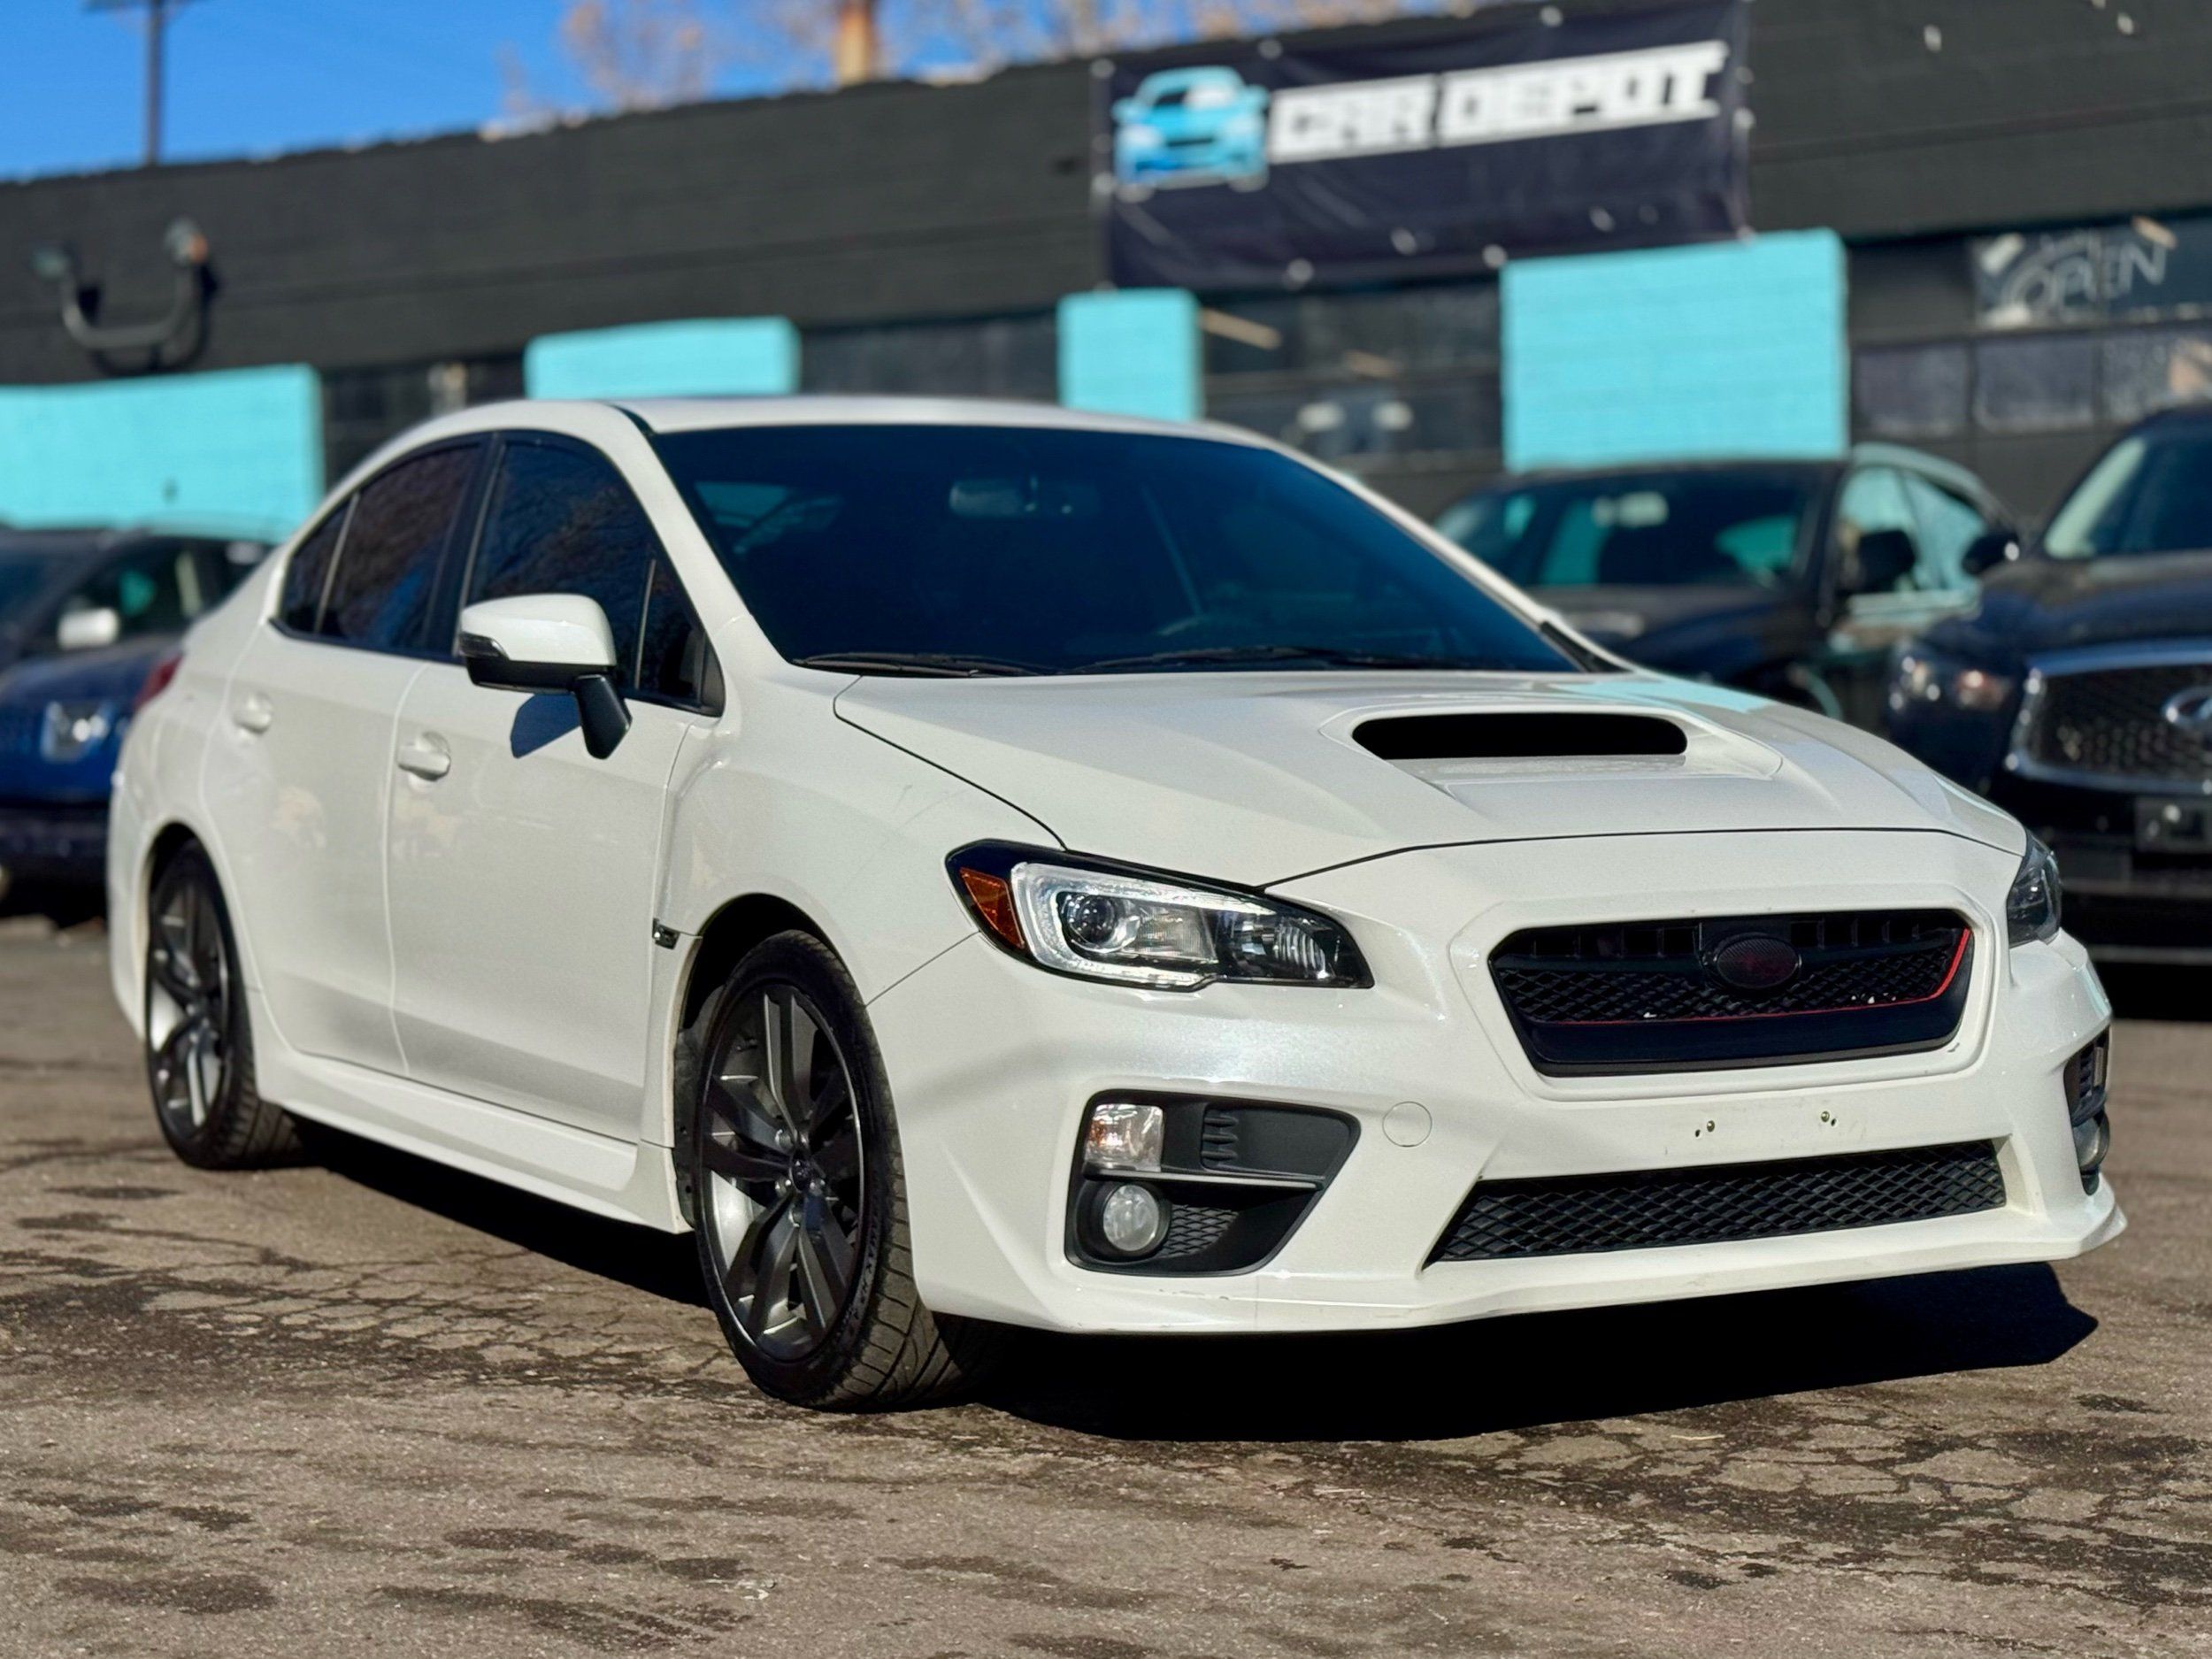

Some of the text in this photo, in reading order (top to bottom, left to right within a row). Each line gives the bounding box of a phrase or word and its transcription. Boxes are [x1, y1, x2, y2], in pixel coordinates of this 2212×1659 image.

[1269, 40, 1726, 164] CAR DEPOT
[2005, 235, 2168, 311] OPEN
